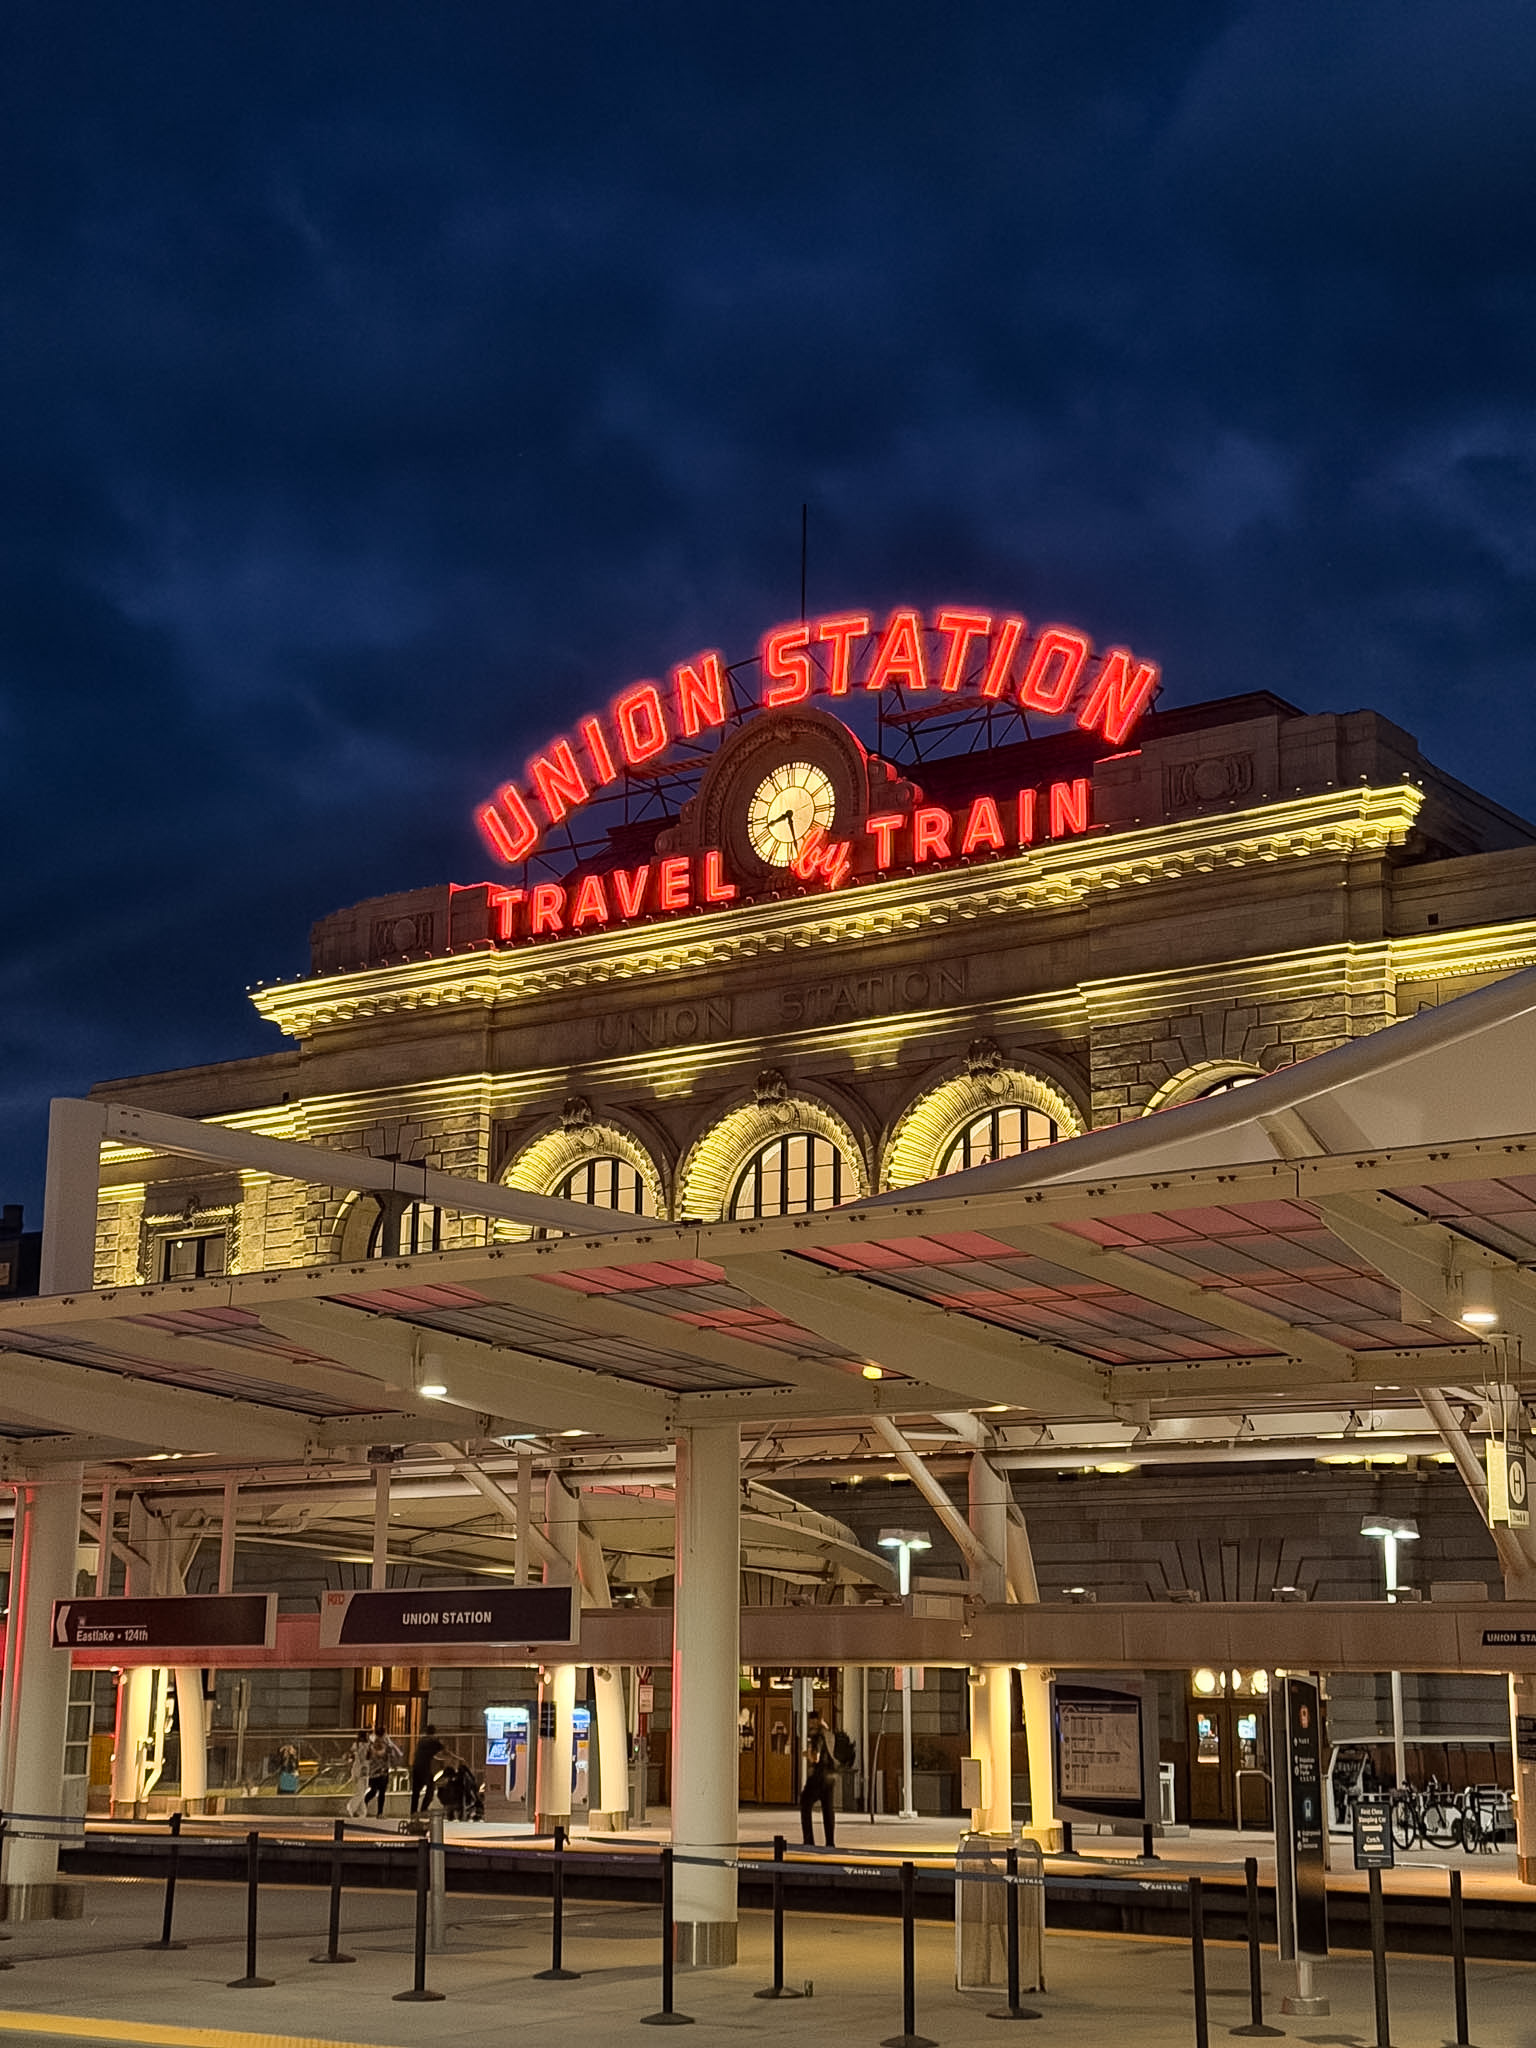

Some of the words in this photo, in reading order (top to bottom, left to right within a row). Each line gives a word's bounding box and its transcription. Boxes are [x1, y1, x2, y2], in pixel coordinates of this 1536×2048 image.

[482, 653, 726, 862] UNION
[766, 609, 1157, 745] STATION
[490, 851, 736, 939] TRAVEL
[790, 828, 851, 889] by
[867, 778, 1089, 869] TRAIN
[595, 999, 733, 1048] UNION
[780, 961, 968, 1023] STATION
[1513, 1467, 1522, 1497] H
[402, 1612, 439, 1626] UNION
[441, 1611, 492, 1625] STATION
[76, 1629, 115, 1642] Eastlake
[124, 1629, 149, 1641] 124th
[1486, 1632, 1517, 1642] UNION
